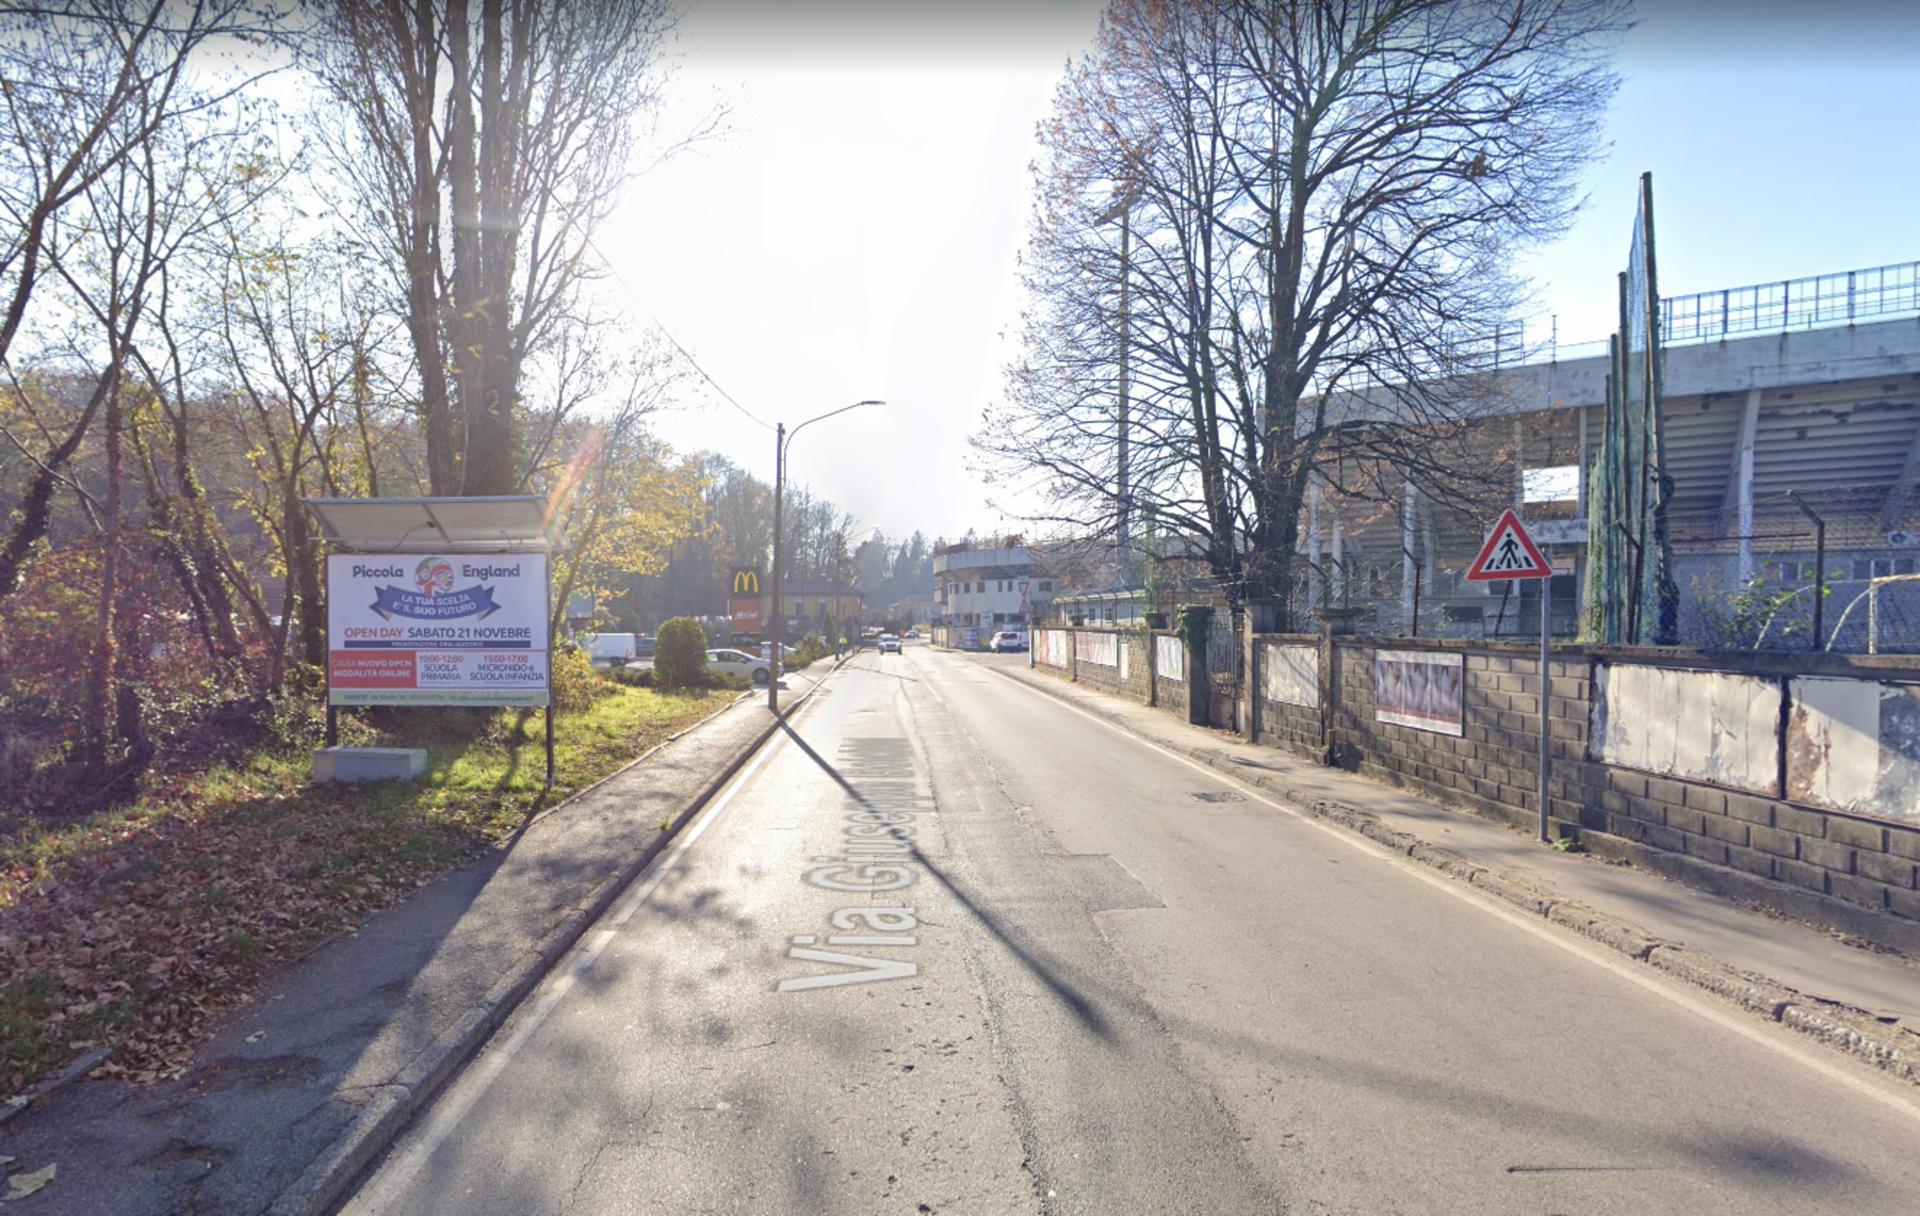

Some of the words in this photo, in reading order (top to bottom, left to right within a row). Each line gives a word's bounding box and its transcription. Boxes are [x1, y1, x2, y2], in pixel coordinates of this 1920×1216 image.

[353, 565, 404, 578] Piccola
[463, 564, 520, 580] England
[401, 594, 413, 603] LA
[415, 596, 435, 605] TUA
[436, 594, 470, 605] SCELTA
[403, 604, 411, 613] IL
[414, 607, 436, 616] SUO
[438, 602, 476, 615] FUTURO
[344, 628, 379, 638] OPEN
[380, 628, 403, 638] DAY
[407, 628, 454, 638] SABATO
[457, 628, 471, 638] 21
[473, 628, 531, 638] NOVEBRE
[419, 655, 464, 663] 10:00-12:00
[483, 655, 529, 663] 15:00-17:00
[357, 660, 387, 668] NUOVO
[424, 664, 458, 672] SCUOLA
[477, 664, 527, 672] MICRONIDO
[378, 669, 412, 678] ONLINE
[421, 672, 462, 680] PRIMARIA
[470, 672, 504, 681] SCUOLA
[505, 672, 544, 681] INFANZIA
